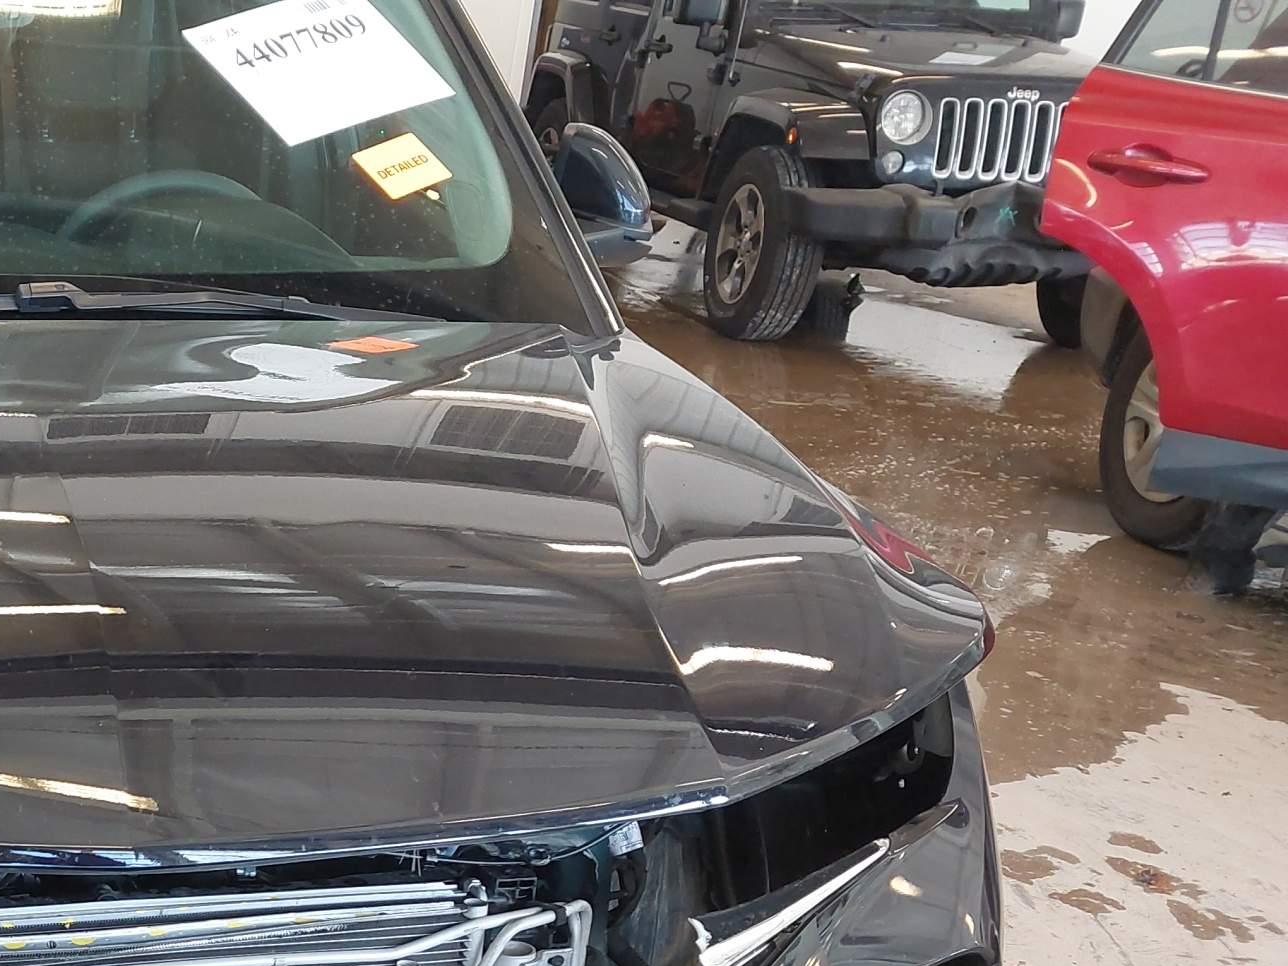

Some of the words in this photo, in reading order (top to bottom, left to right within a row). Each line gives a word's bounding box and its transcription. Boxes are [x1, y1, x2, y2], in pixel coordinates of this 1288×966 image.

[235, 13, 367, 69] 44077809
[1007, 86, 1040, 102] Jeep
[376, 153, 429, 181] DETAILED
